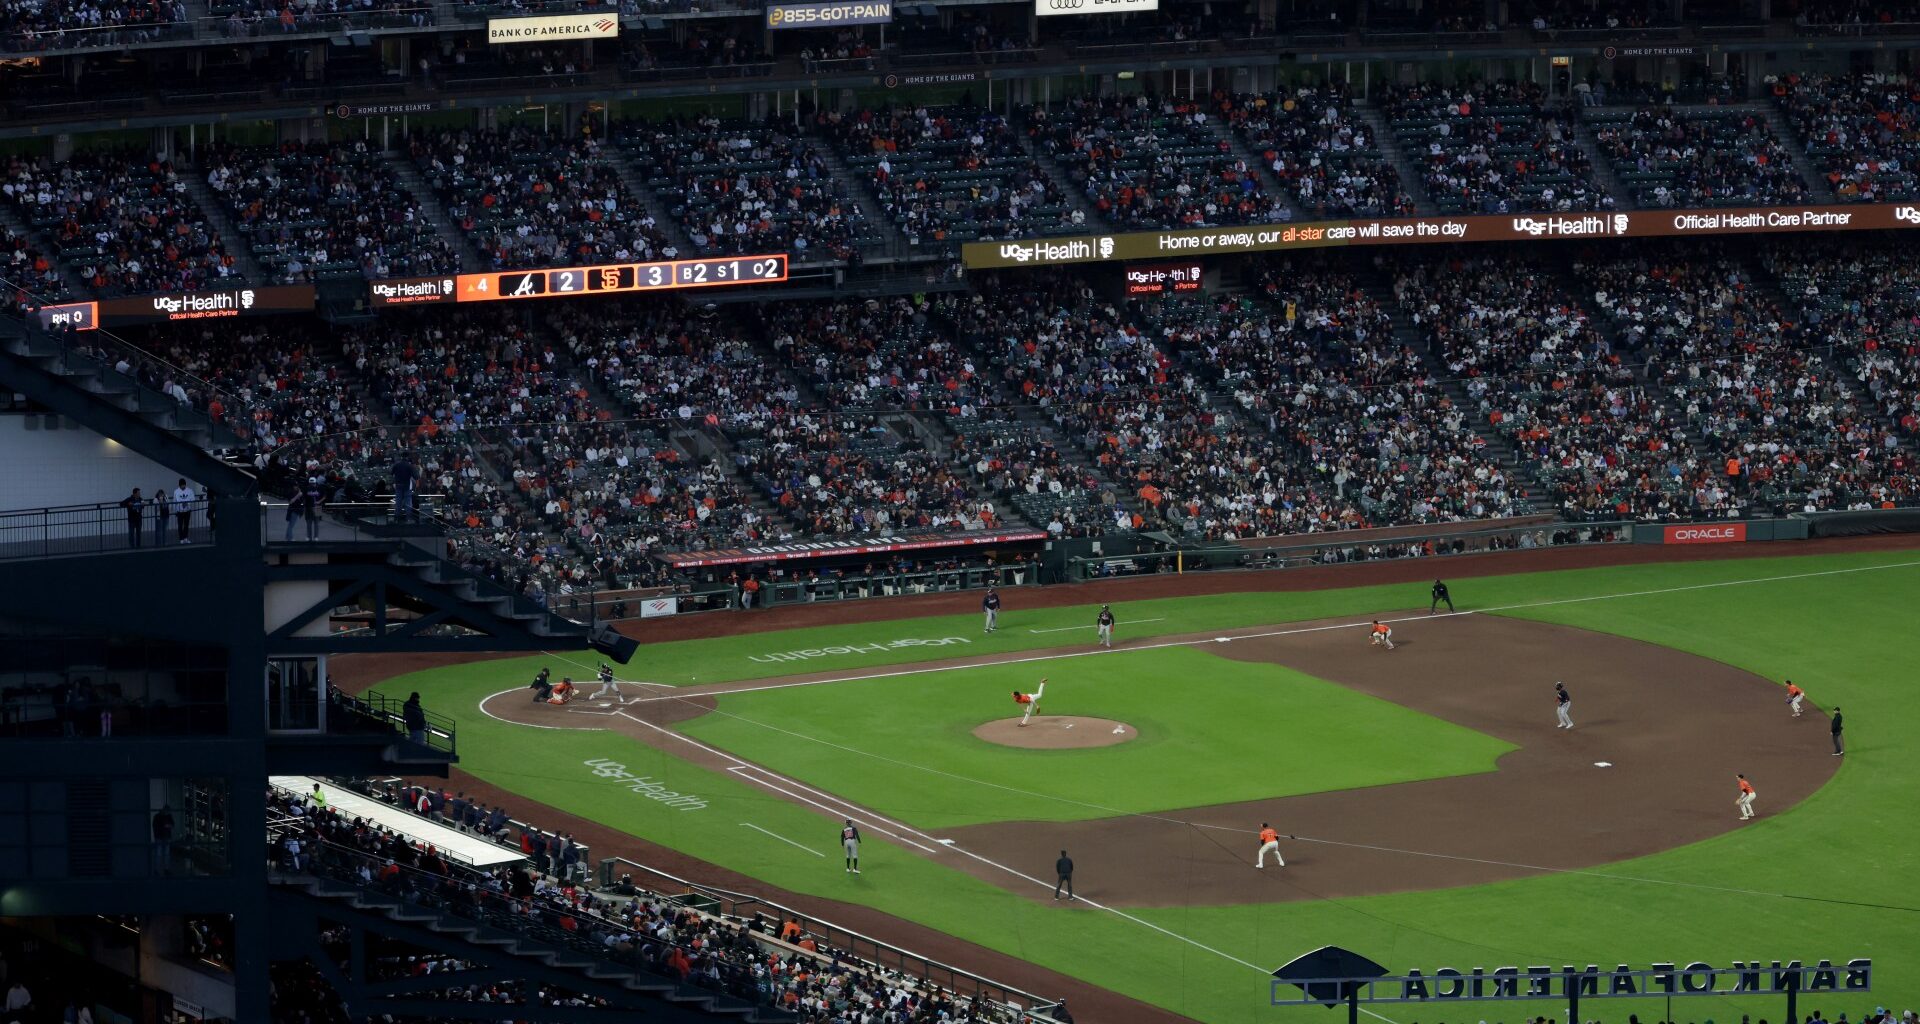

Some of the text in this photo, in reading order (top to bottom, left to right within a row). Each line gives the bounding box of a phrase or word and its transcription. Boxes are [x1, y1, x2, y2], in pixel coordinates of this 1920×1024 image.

[784, 4, 890, 22] 855-GOT-PAIN
[491, 25, 591, 38] BANK OF AMERICA
[1513, 218, 1546, 235] UCSF
[1548, 216, 1604, 235] Health
[1674, 211, 1852, 229] Official Health Care Partner
[1159, 220, 1467, 250] Home or away, our all-star care will save the day
[1000, 244, 1033, 262] UCSF
[1035, 240, 1090, 260] Health
[477, 278, 488, 292] 4
[560, 272, 574, 292] 2
[648, 266, 662, 286] 3
[1128, 272, 1150, 283] UCSF
[1150, 269, 1184, 282] Helth
[373, 284, 396, 297] UCSF
[398, 282, 436, 296] Health
[154, 296, 181, 312] UCSF
[183, 292, 232, 311] Health
[74, 310, 82, 322] 0
[188, 311, 205, 319] Health
[1676, 528, 1735, 540] ORACLE
[747, 540, 861, 554] FRANCISCO
[748, 642, 890, 662] Health
[584, 758, 710, 811] UCSF Health
